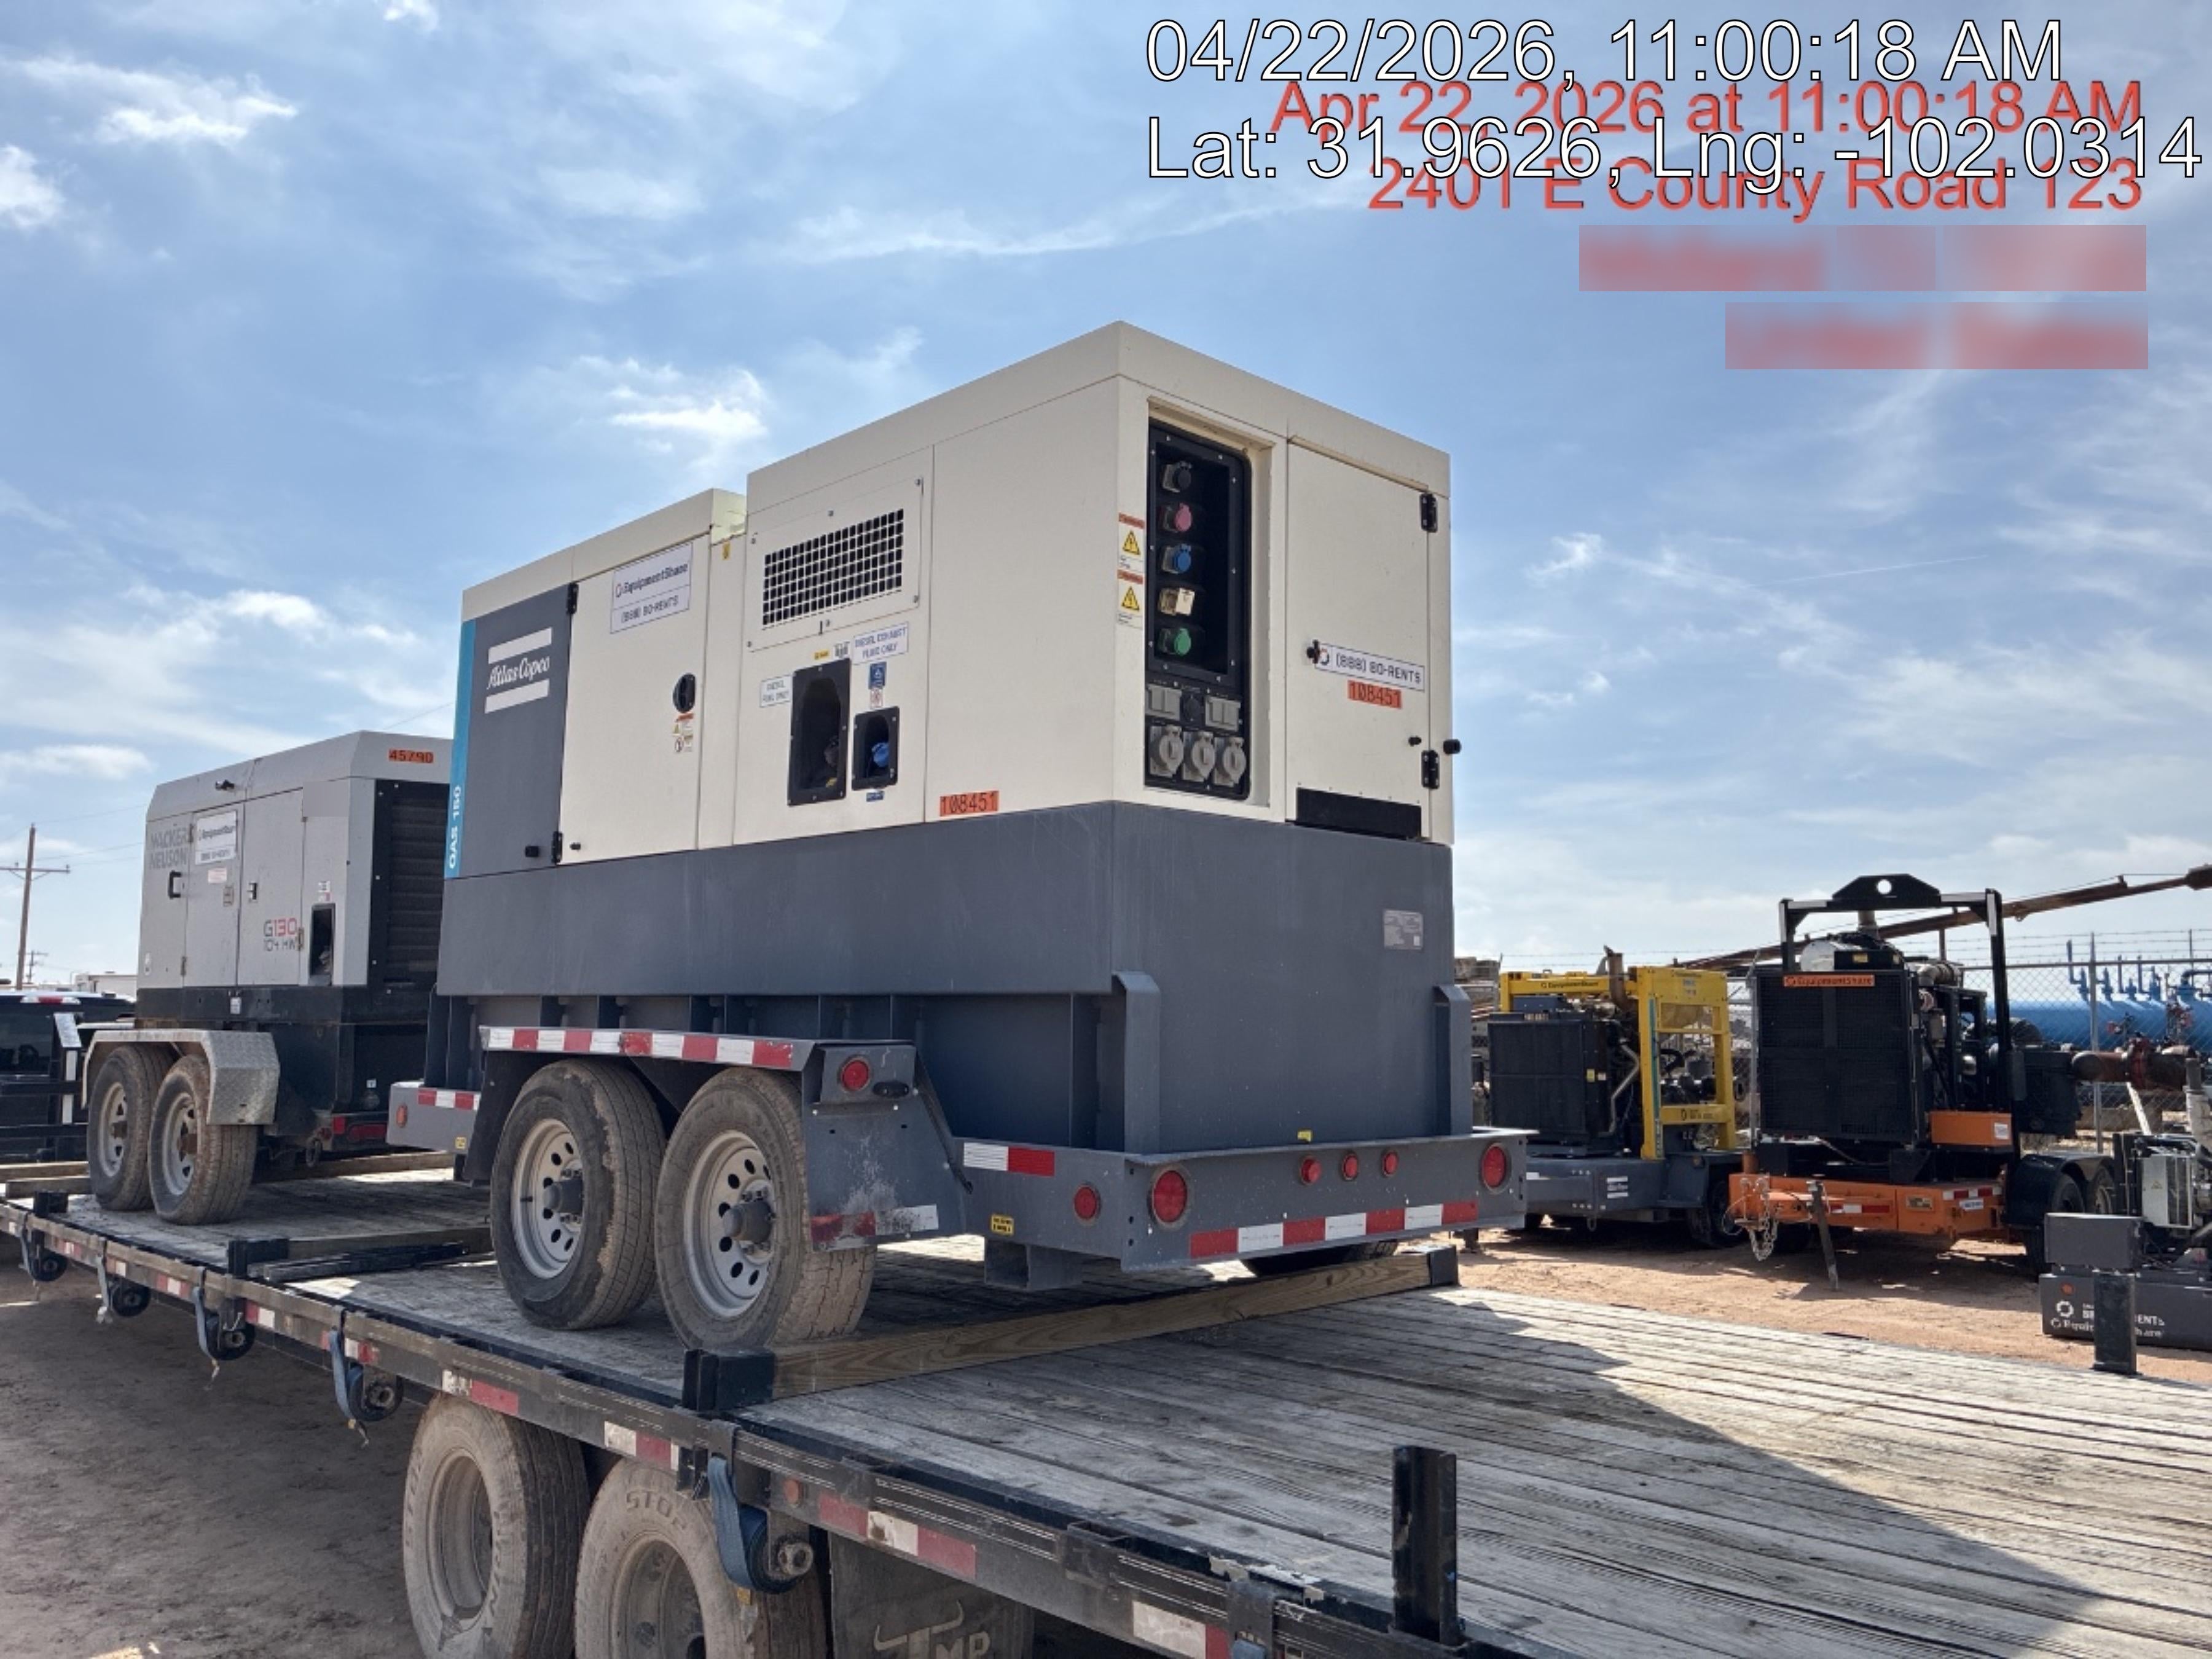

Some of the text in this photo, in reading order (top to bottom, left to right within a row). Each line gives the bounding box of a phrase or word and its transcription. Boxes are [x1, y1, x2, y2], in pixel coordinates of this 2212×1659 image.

[1336, 653, 1421, 684] (888) 80-RENTS
[1349, 681, 1402, 708] 108451
[940, 791, 998, 816] 108451
